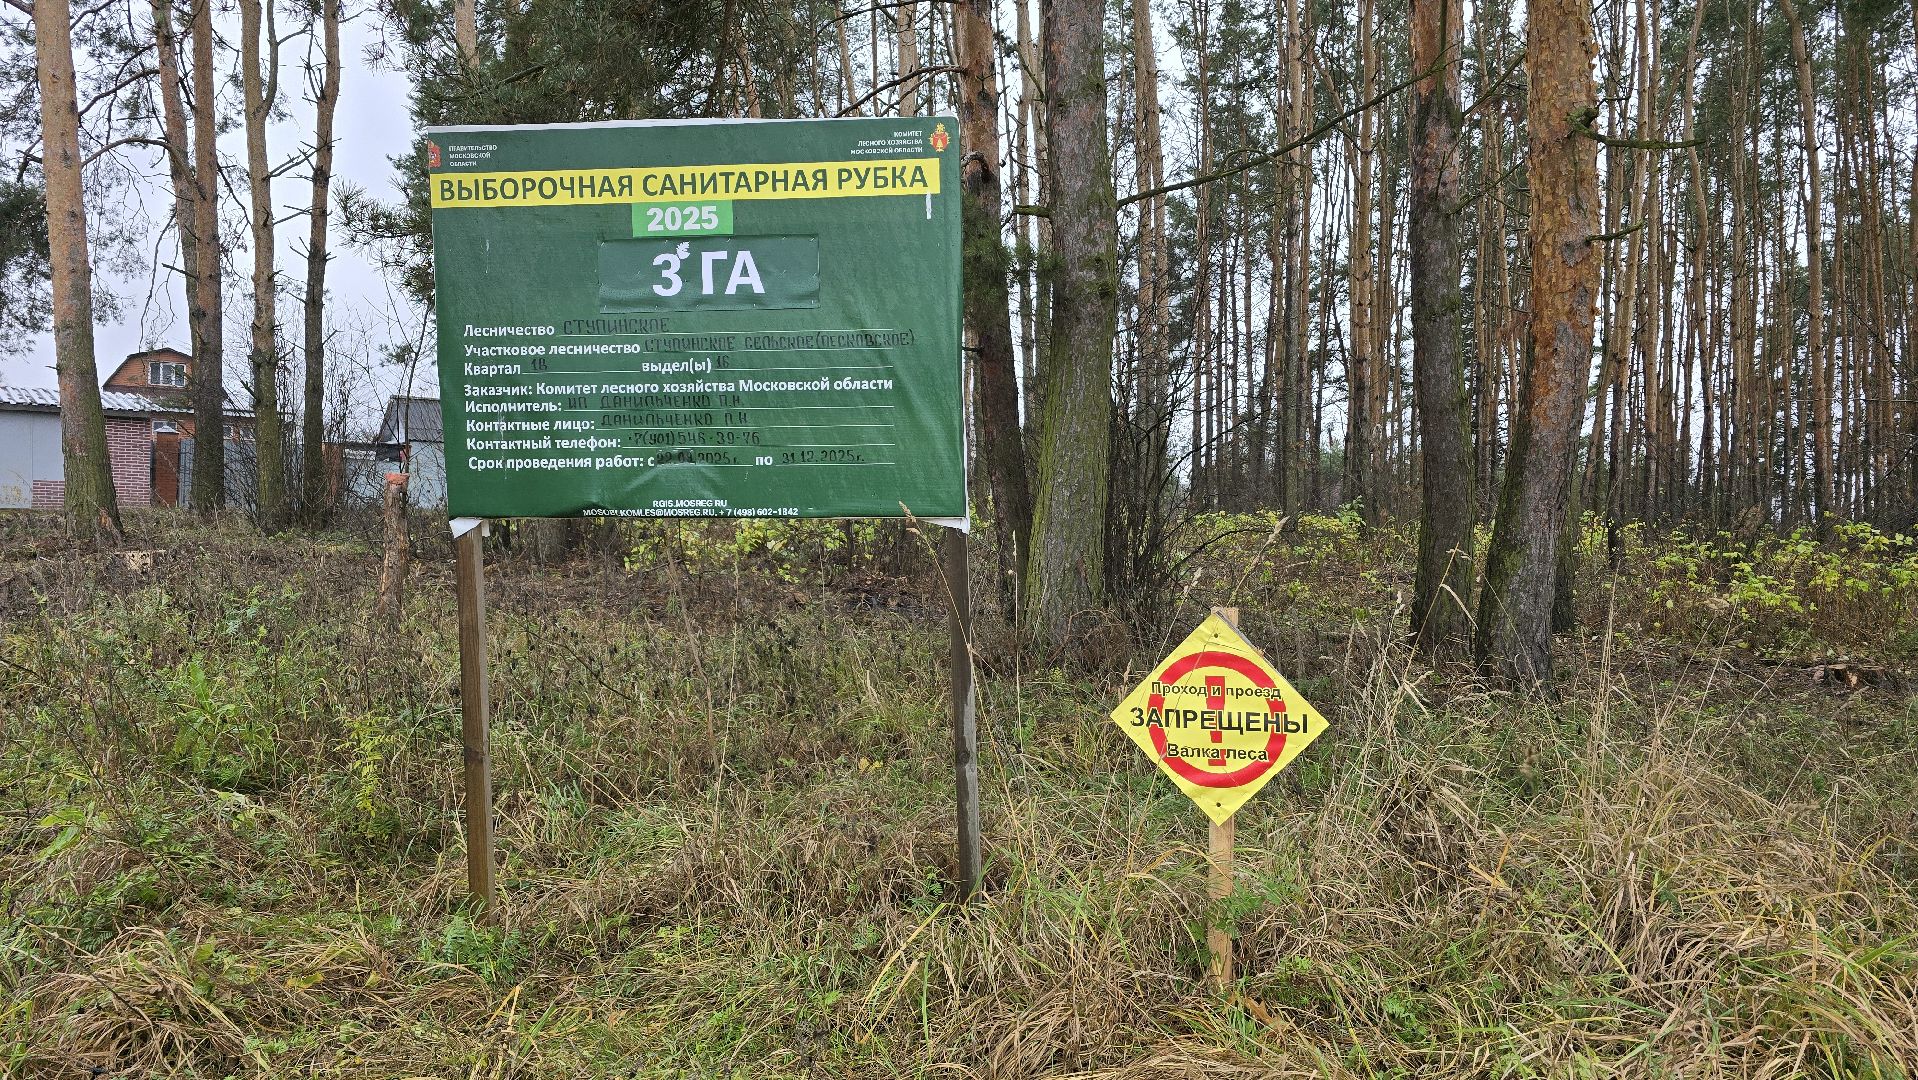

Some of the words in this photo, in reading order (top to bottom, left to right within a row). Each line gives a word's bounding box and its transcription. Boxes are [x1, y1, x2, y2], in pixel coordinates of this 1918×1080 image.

[893, 130, 923, 138] КОМИТЕТ
[440, 174, 633, 201] ВЫБОРОЧНАЯ
[642, 169, 828, 196] САНИТАРНАЯ
[837, 165, 929, 190] РУБКА
[646, 205, 719, 231] 2025
[652, 252, 683, 297] 3
[701, 250, 766, 295] ГА
[463, 324, 555, 337] Лесничество
[463, 344, 546, 357] Участковое
[548, 343, 641, 355] лесничество
[463, 362, 521, 377] Квартал
[642, 357, 712, 374] выдел(ы)
[463, 384, 533, 397] Заказчик:
[536, 382, 598, 395] Комитет
[600, 382, 659, 394] лесного
[662, 378, 735, 393] хозяйства
[739, 377, 830, 391] Московской
[833, 377, 893, 390] области
[464, 400, 563, 413] Исполнитель:
[466, 419, 550, 432] Контактные
[553, 419, 595, 432] лицо:
[466, 435, 552, 450] Контактный
[555, 435, 621, 451] телефон:
[468, 457, 503, 471] Срок
[506, 456, 592, 470] проведения
[595, 455, 644, 470] работ:
[647, 456, 655, 467] с
[755, 456, 773, 466] по
[756, 507, 799, 516] 602-1842
[1151, 681, 1208, 697] Проход
[1211, 686, 1221, 696] и
[1226, 686, 1282, 700] проезд
[1130, 706, 1308, 735] ЗАПРЕЩЕНЫ
[1167, 743, 1220, 759] Валка
[1225, 749, 1268, 761] леса
